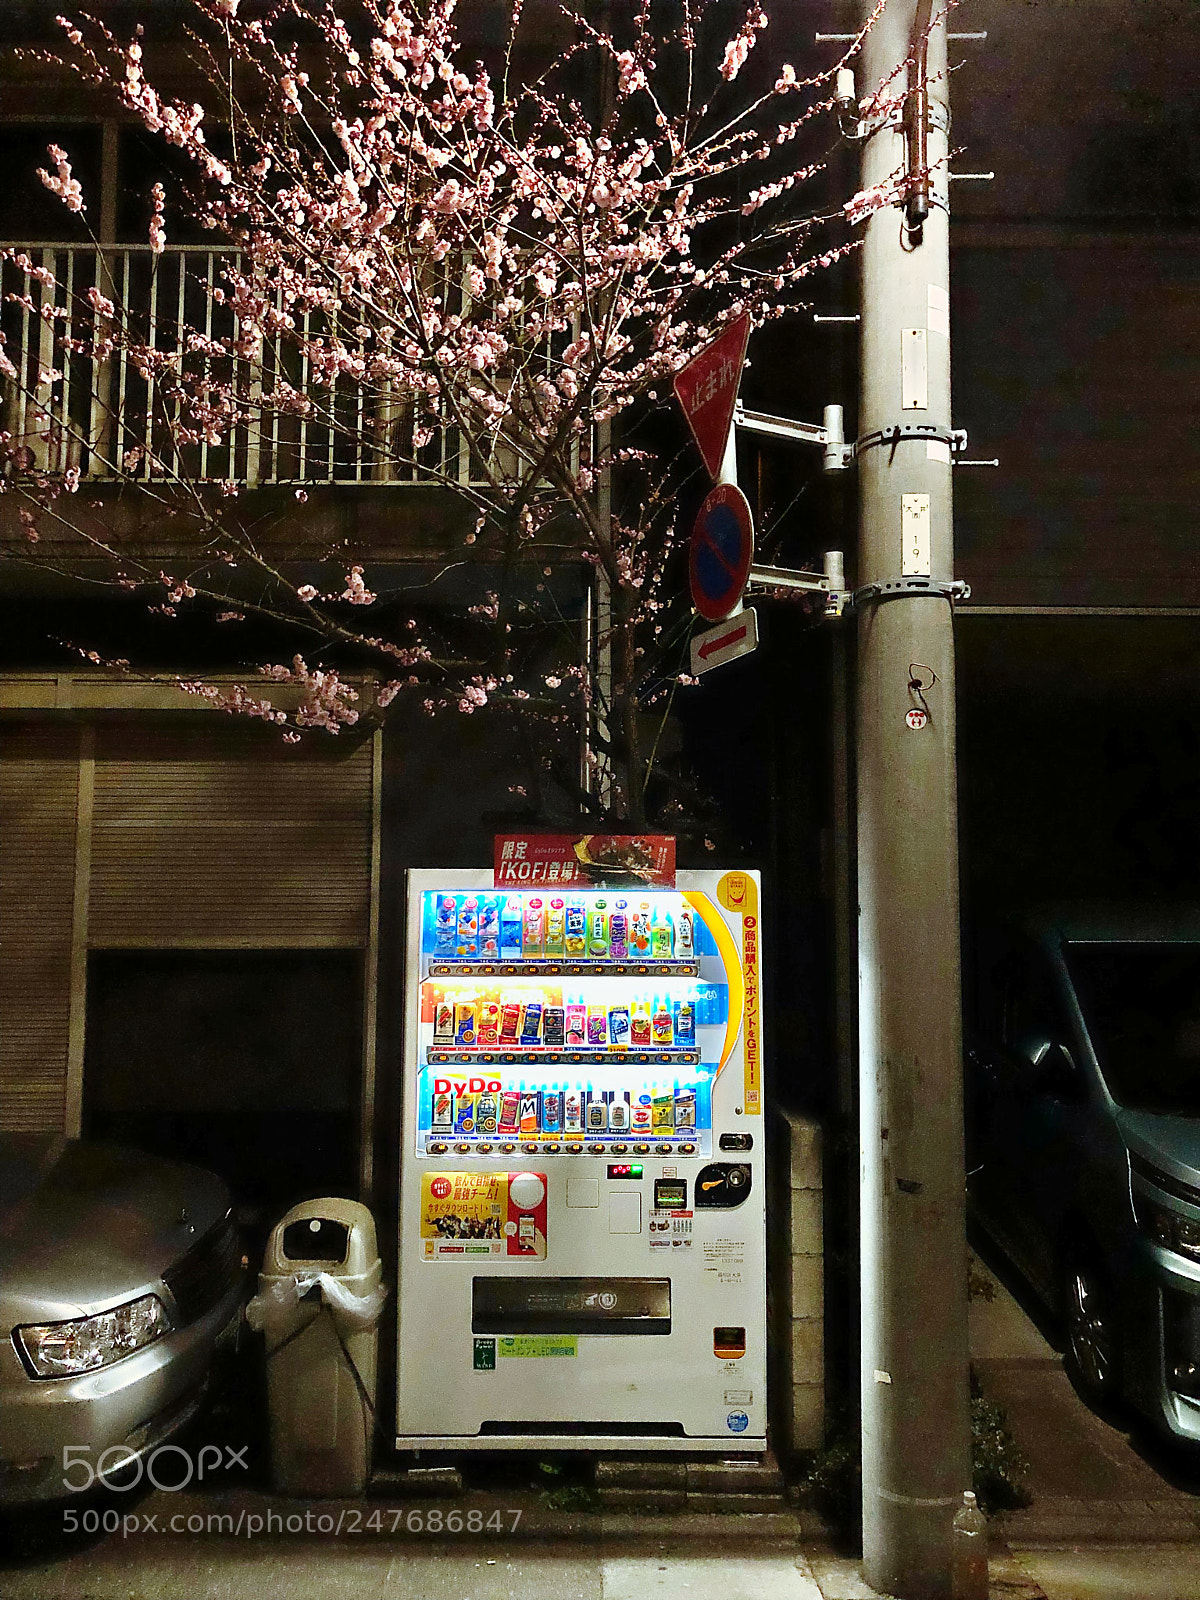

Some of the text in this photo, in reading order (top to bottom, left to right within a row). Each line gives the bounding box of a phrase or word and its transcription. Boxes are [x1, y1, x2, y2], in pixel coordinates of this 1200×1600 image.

[690, 357, 735, 416] 止まれ
[706, 487, 727, 513] 8-20
[501, 840, 528, 859] 限定
[499, 861, 579, 881] 「KOF」登場!
[434, 1078, 502, 1099] DyDo
[453, 1188, 499, 1200] 最強チーム!
